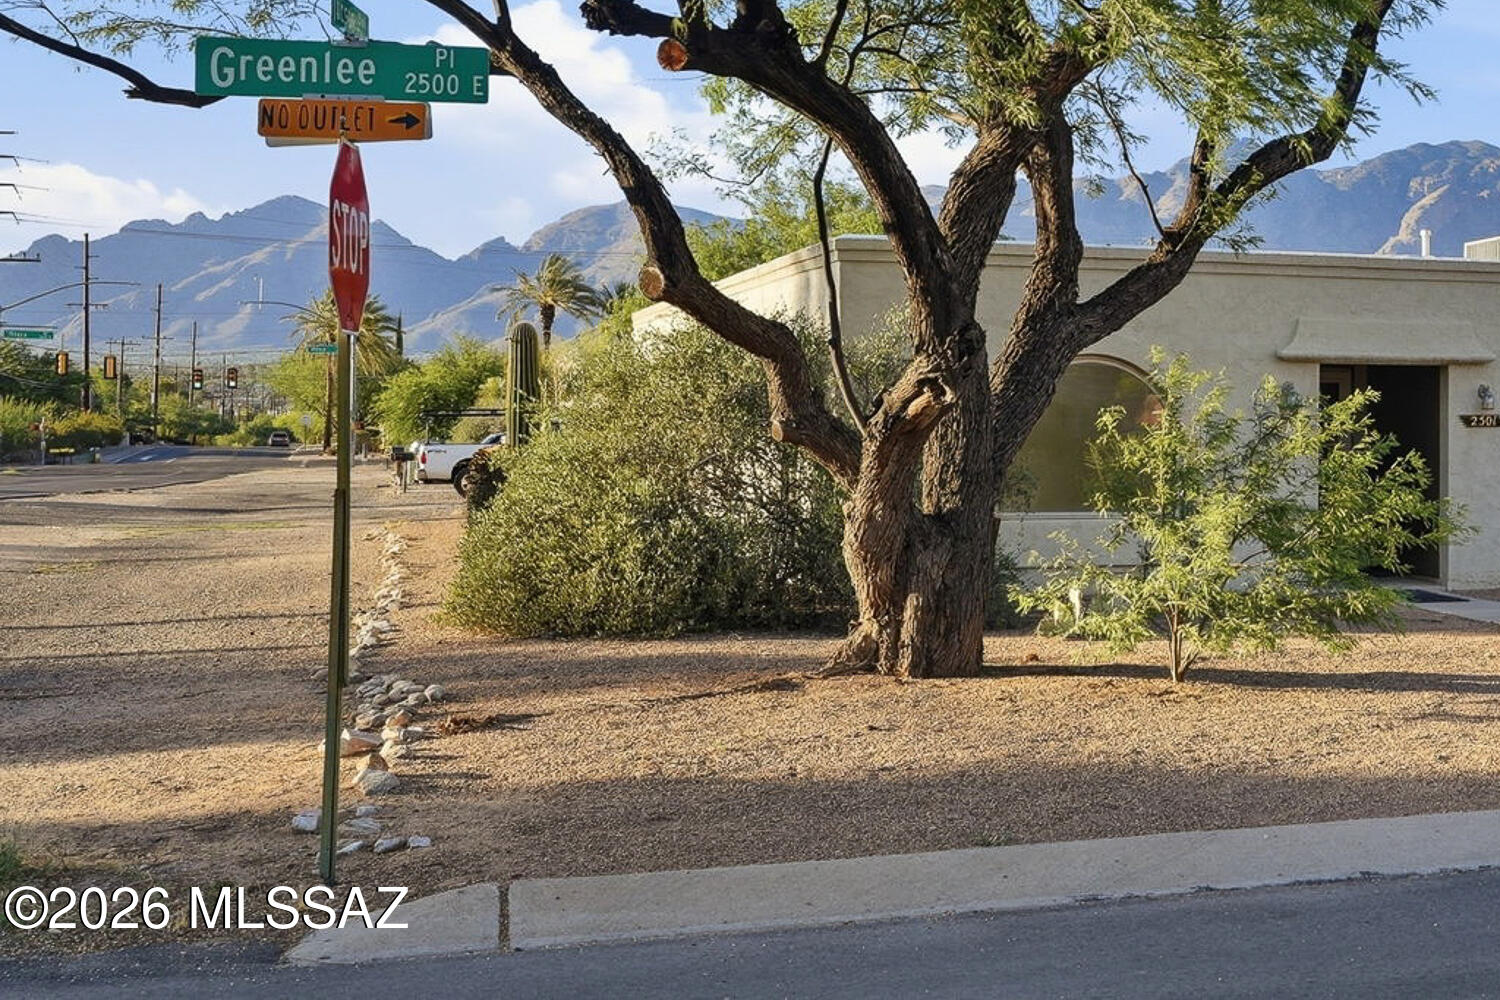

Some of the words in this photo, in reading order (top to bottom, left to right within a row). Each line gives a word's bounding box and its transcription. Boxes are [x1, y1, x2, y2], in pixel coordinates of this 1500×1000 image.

[210, 46, 376, 89] Greenlee
[404, 73, 460, 95] 2500
[473, 75, 484, 96] E
[261, 104, 289, 129] NO
[299, 104, 375, 131] OUTLET
[332, 199, 368, 275] STOP
